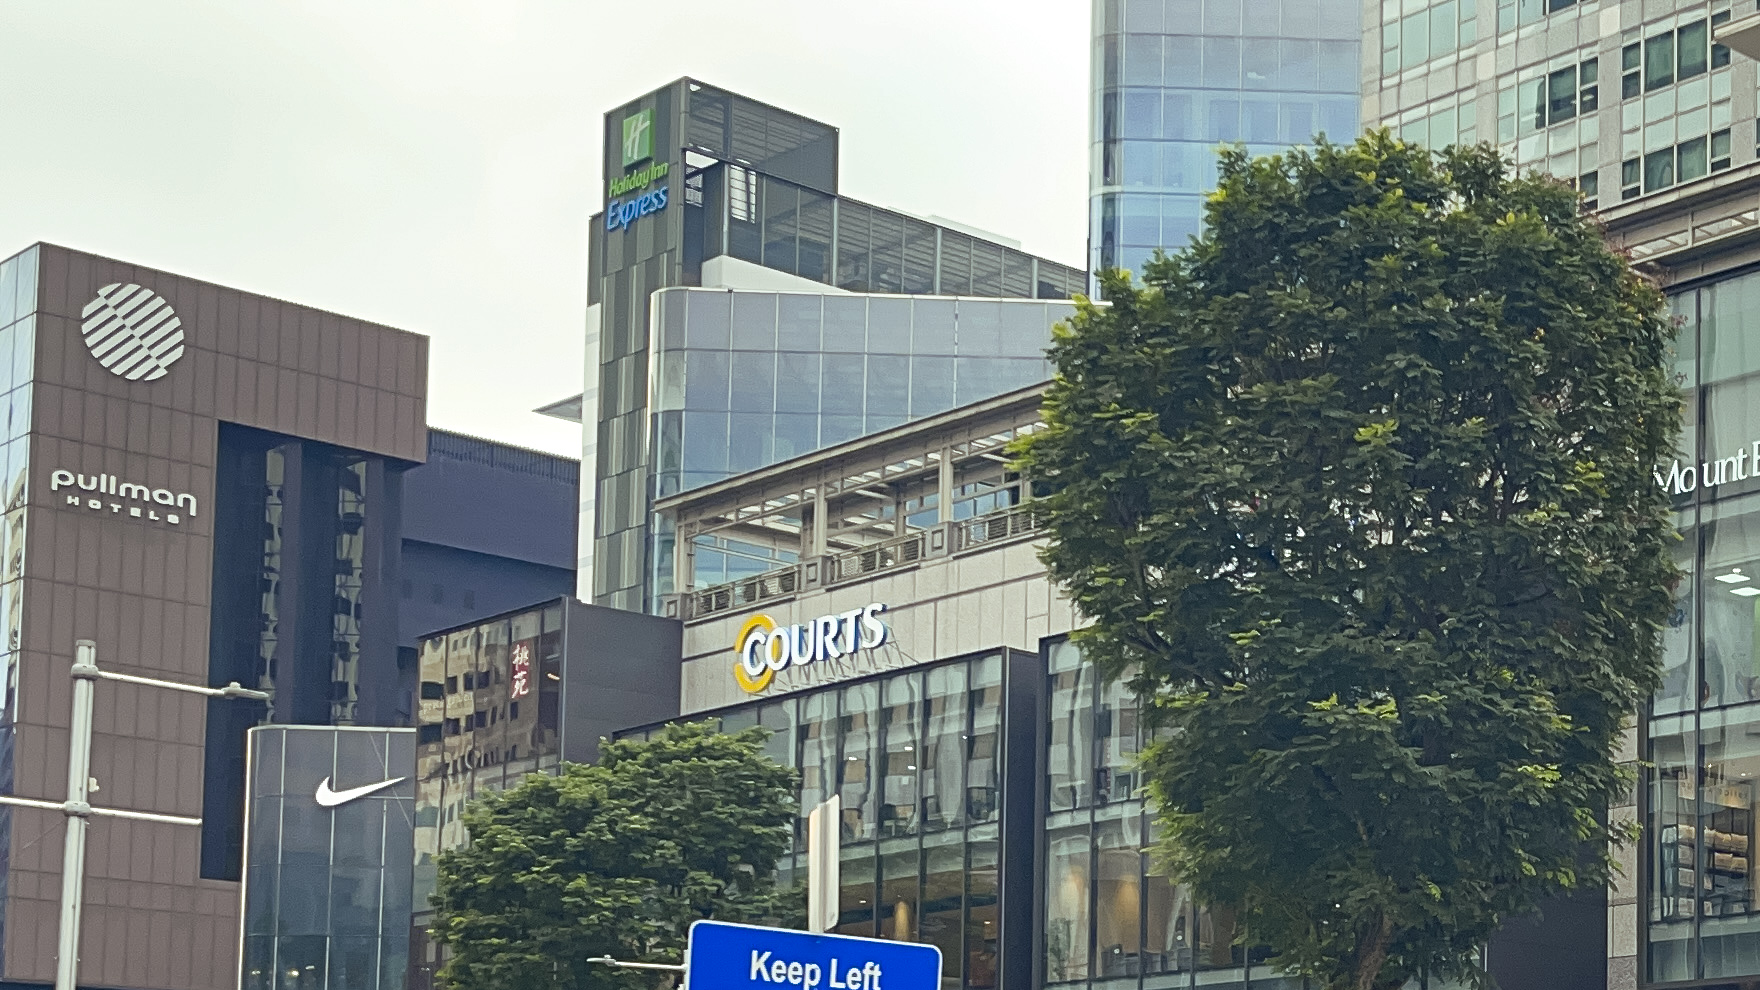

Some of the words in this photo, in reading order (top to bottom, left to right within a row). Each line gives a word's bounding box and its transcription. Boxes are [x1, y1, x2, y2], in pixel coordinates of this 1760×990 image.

[608, 170, 650, 199] Holiday
[650, 161, 669, 179] Inn
[606, 185, 669, 231] Express
[51, 469, 198, 517] pullman
[1653, 447, 1749, 495] Mount
[66, 495, 180, 525] HOTELS
[740, 602, 886, 679] COURTS
